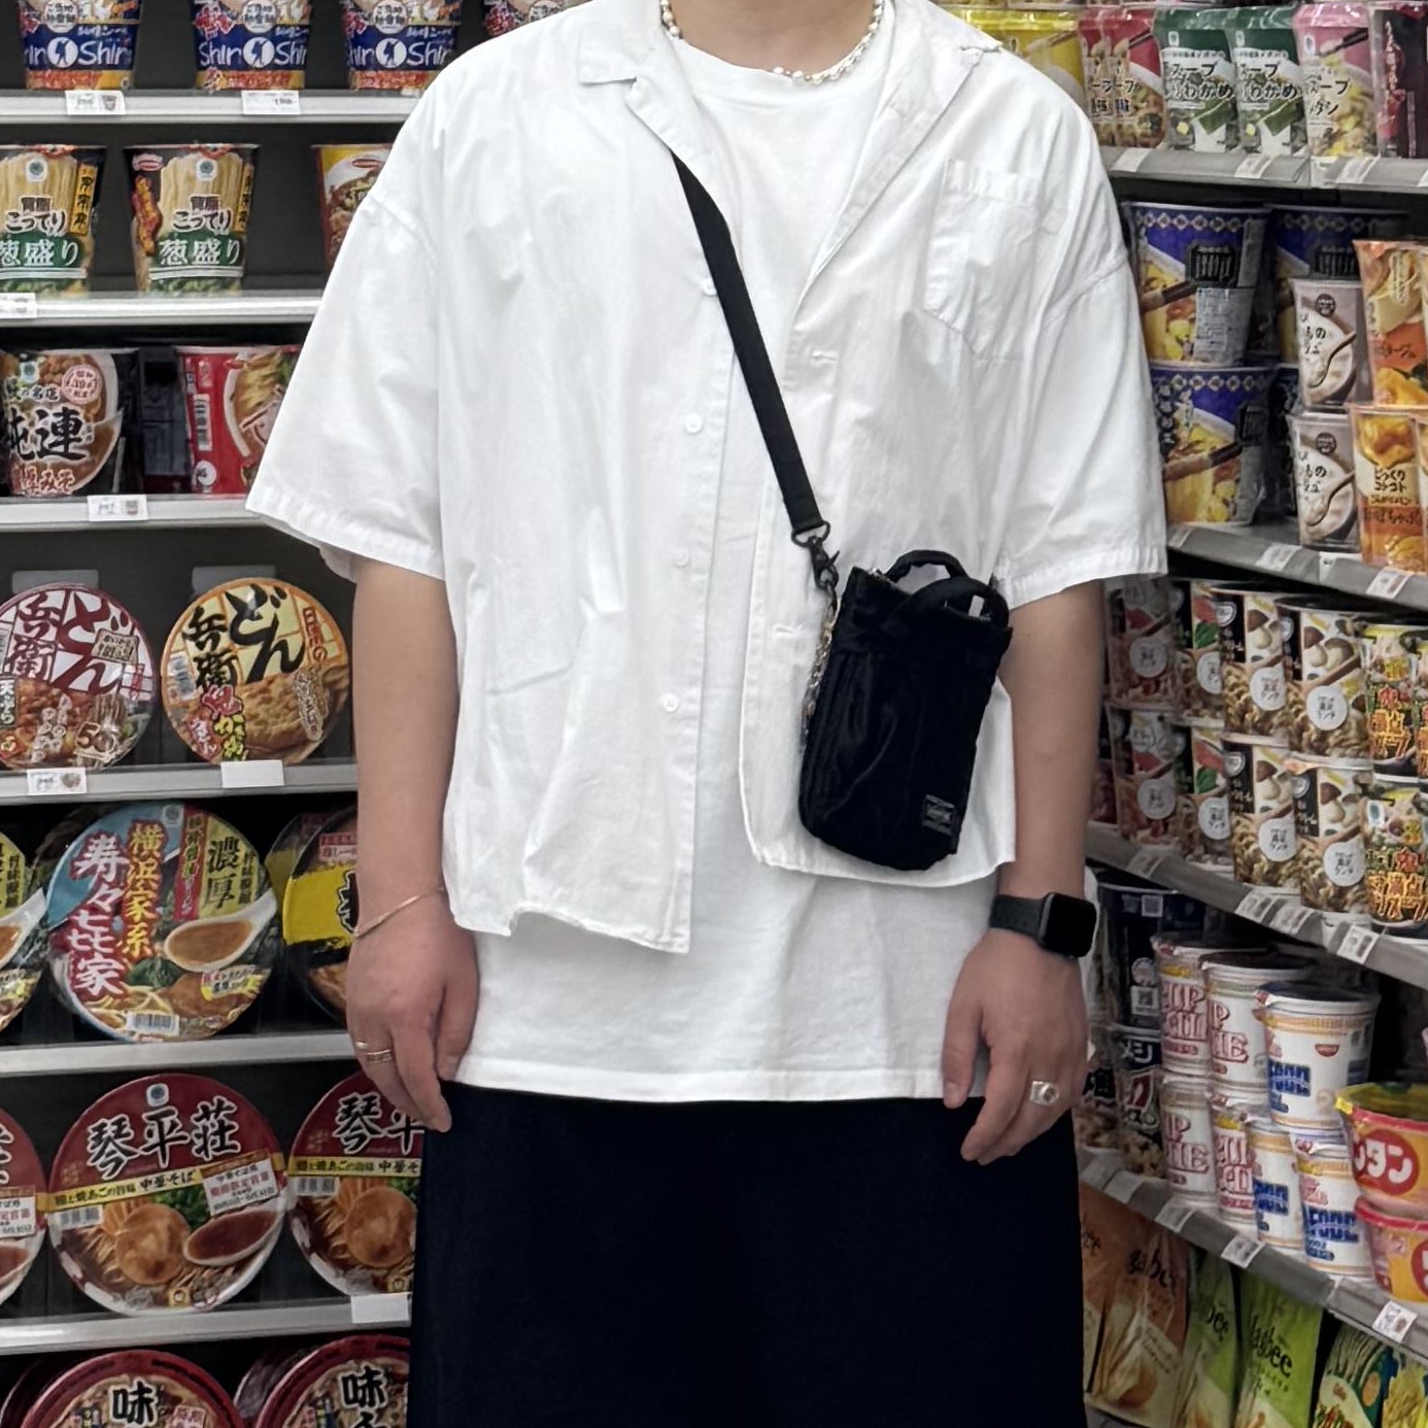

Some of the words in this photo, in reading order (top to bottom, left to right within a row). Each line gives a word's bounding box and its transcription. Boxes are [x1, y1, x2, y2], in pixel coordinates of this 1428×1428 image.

[126, 822, 167, 958] 横浜家系
[201, 837, 239, 918] 濃厚
[86, 1096, 243, 1168] 琴平荘
